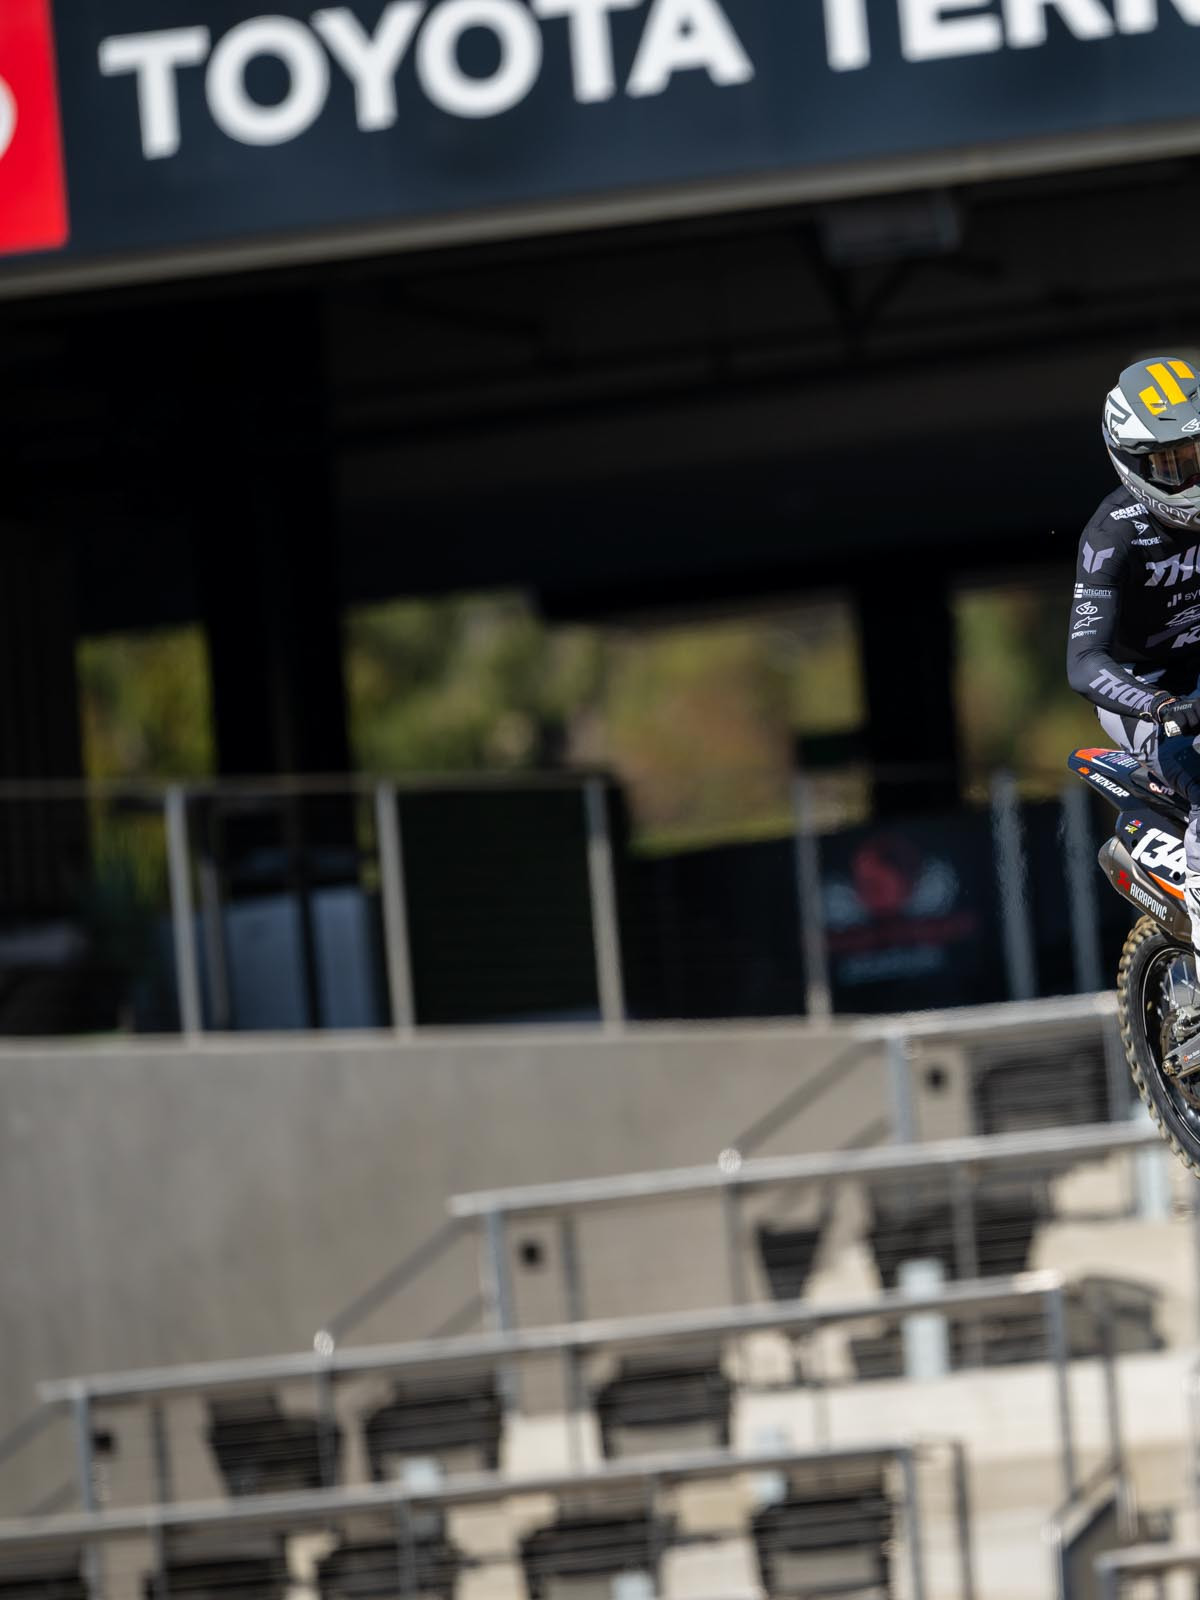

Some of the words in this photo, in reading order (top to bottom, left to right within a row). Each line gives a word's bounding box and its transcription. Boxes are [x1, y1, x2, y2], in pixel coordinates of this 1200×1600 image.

[98, 0, 756, 161] TOYOTA
[1089, 668, 1155, 717] THOR
[1089, 772, 1131, 798] DUNLOP
[1131, 827, 1187, 878] 134
